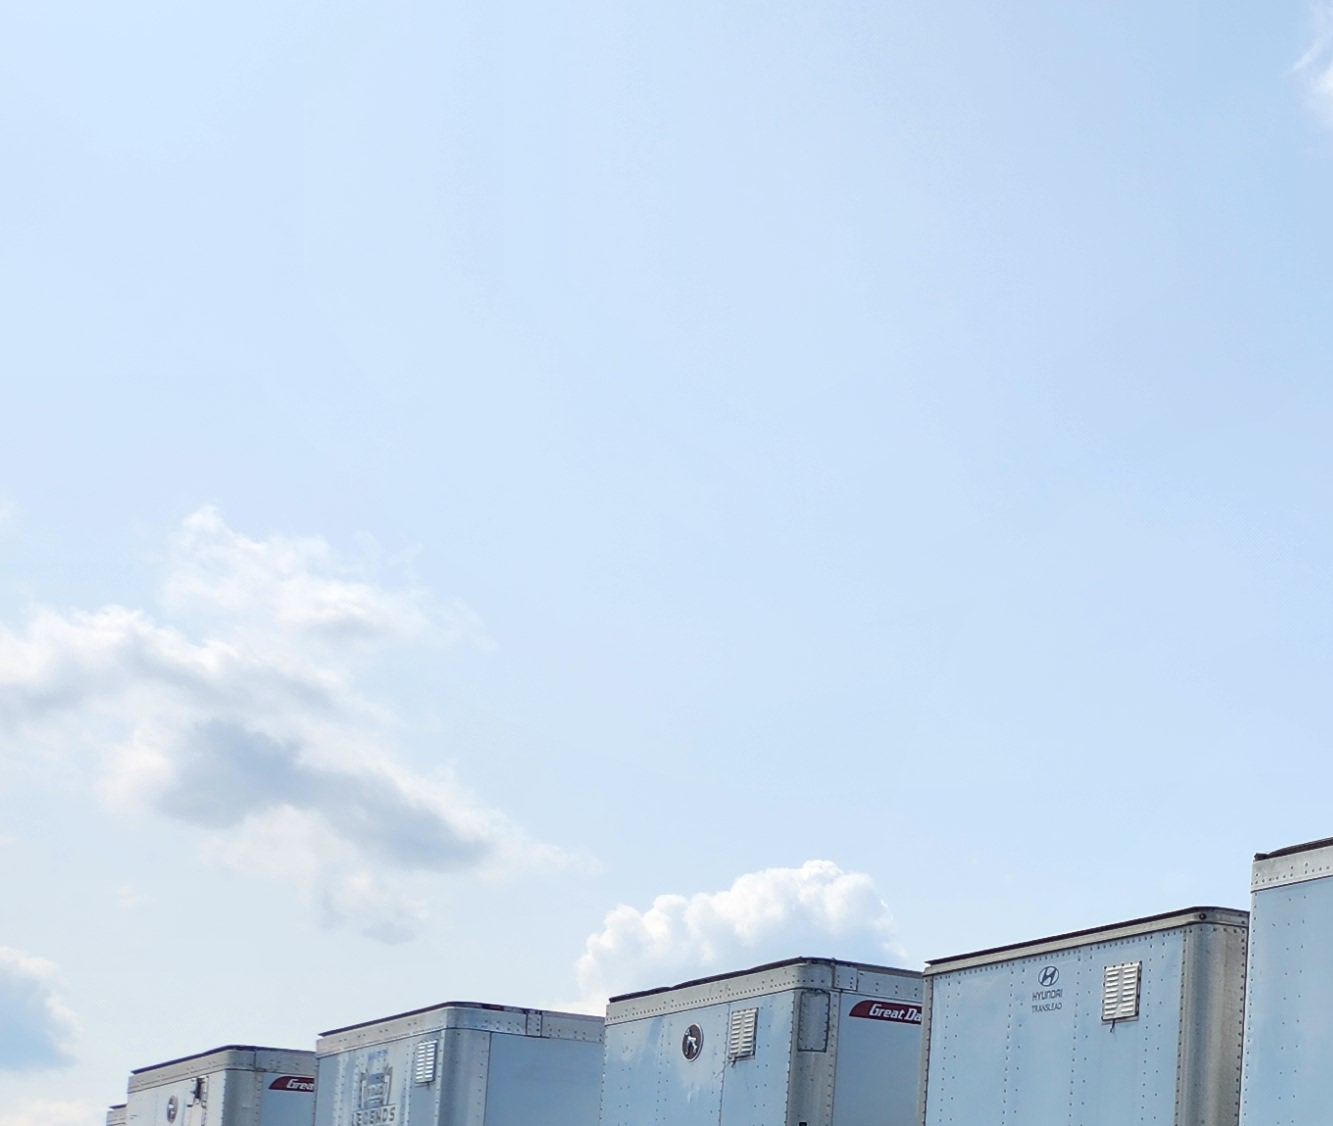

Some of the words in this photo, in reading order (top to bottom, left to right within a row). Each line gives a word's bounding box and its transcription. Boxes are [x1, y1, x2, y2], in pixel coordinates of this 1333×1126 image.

[1032, 989, 1063, 1001] HYUNDAI
[869, 1003, 905, 1019] Great
[904, 1008, 923, 1021] Da
[286, 1079, 315, 1091] Grea
